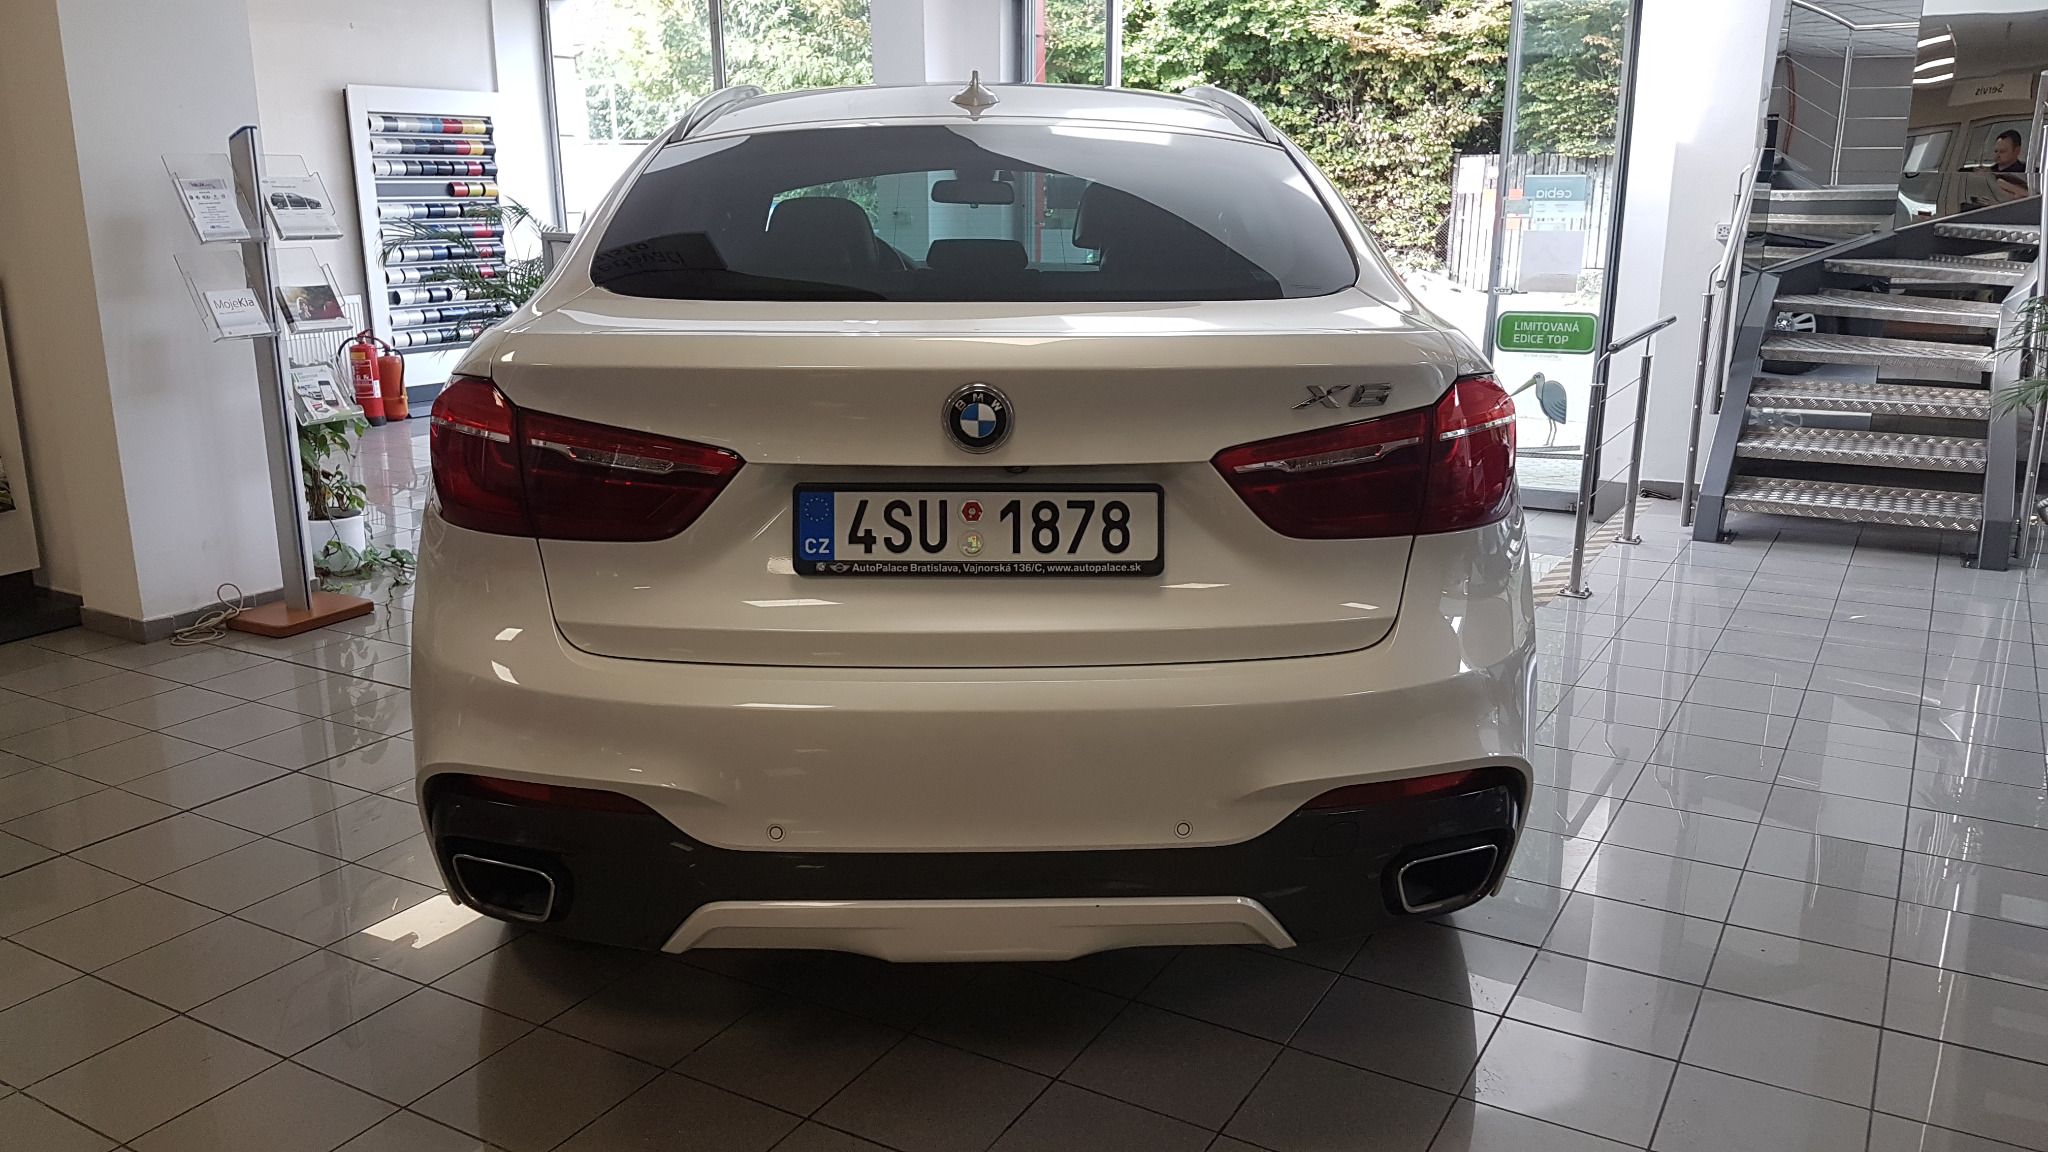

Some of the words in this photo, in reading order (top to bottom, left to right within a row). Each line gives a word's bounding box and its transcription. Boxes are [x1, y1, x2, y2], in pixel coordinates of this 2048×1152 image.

[213, 297, 255, 310] MojeKia
[1514, 321, 1580, 332] LIMITOVANÁ
[1513, 334, 1544, 344] EDICE
[1547, 335, 1569, 344] TOP
[955, 393, 1003, 412] BMW
[1290, 383, 1392, 409] X6
[848, 500, 948, 554] 4SU
[1000, 500, 1131, 554] 1878
[805, 538, 830, 554] CZ
[852, 563, 908, 573] AutoPalace
[910, 563, 961, 574] Bratislava,
[963, 563, 1011, 574] Vajnorská
[1013, 563, 1045, 573] 136/C,
[1047, 563, 1142, 574] www.autopalace.sk
